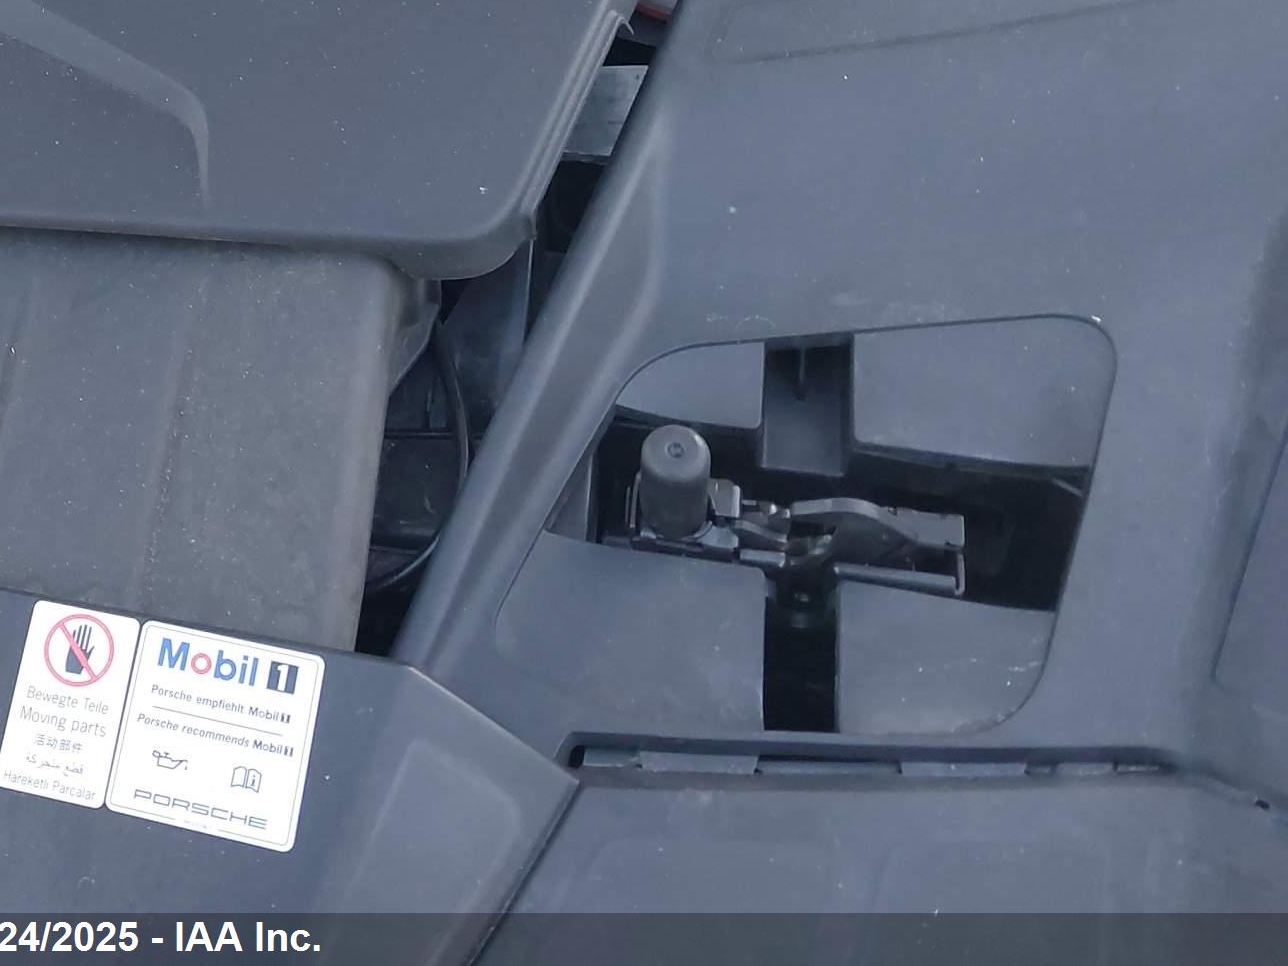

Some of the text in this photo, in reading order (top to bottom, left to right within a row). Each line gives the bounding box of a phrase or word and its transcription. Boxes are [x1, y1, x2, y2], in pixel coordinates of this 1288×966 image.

[157, 637, 259, 686] Mobil
[26, 685, 109, 714] Bewegte Teile
[150, 684, 193, 702] Porsche
[196, 695, 245, 715] empfiehlt
[19, 705, 107, 738] Moving parts
[136, 713, 179, 731] Porsche
[181, 724, 251, 747] recommends
[133, 788, 268, 830] PORSCHE
